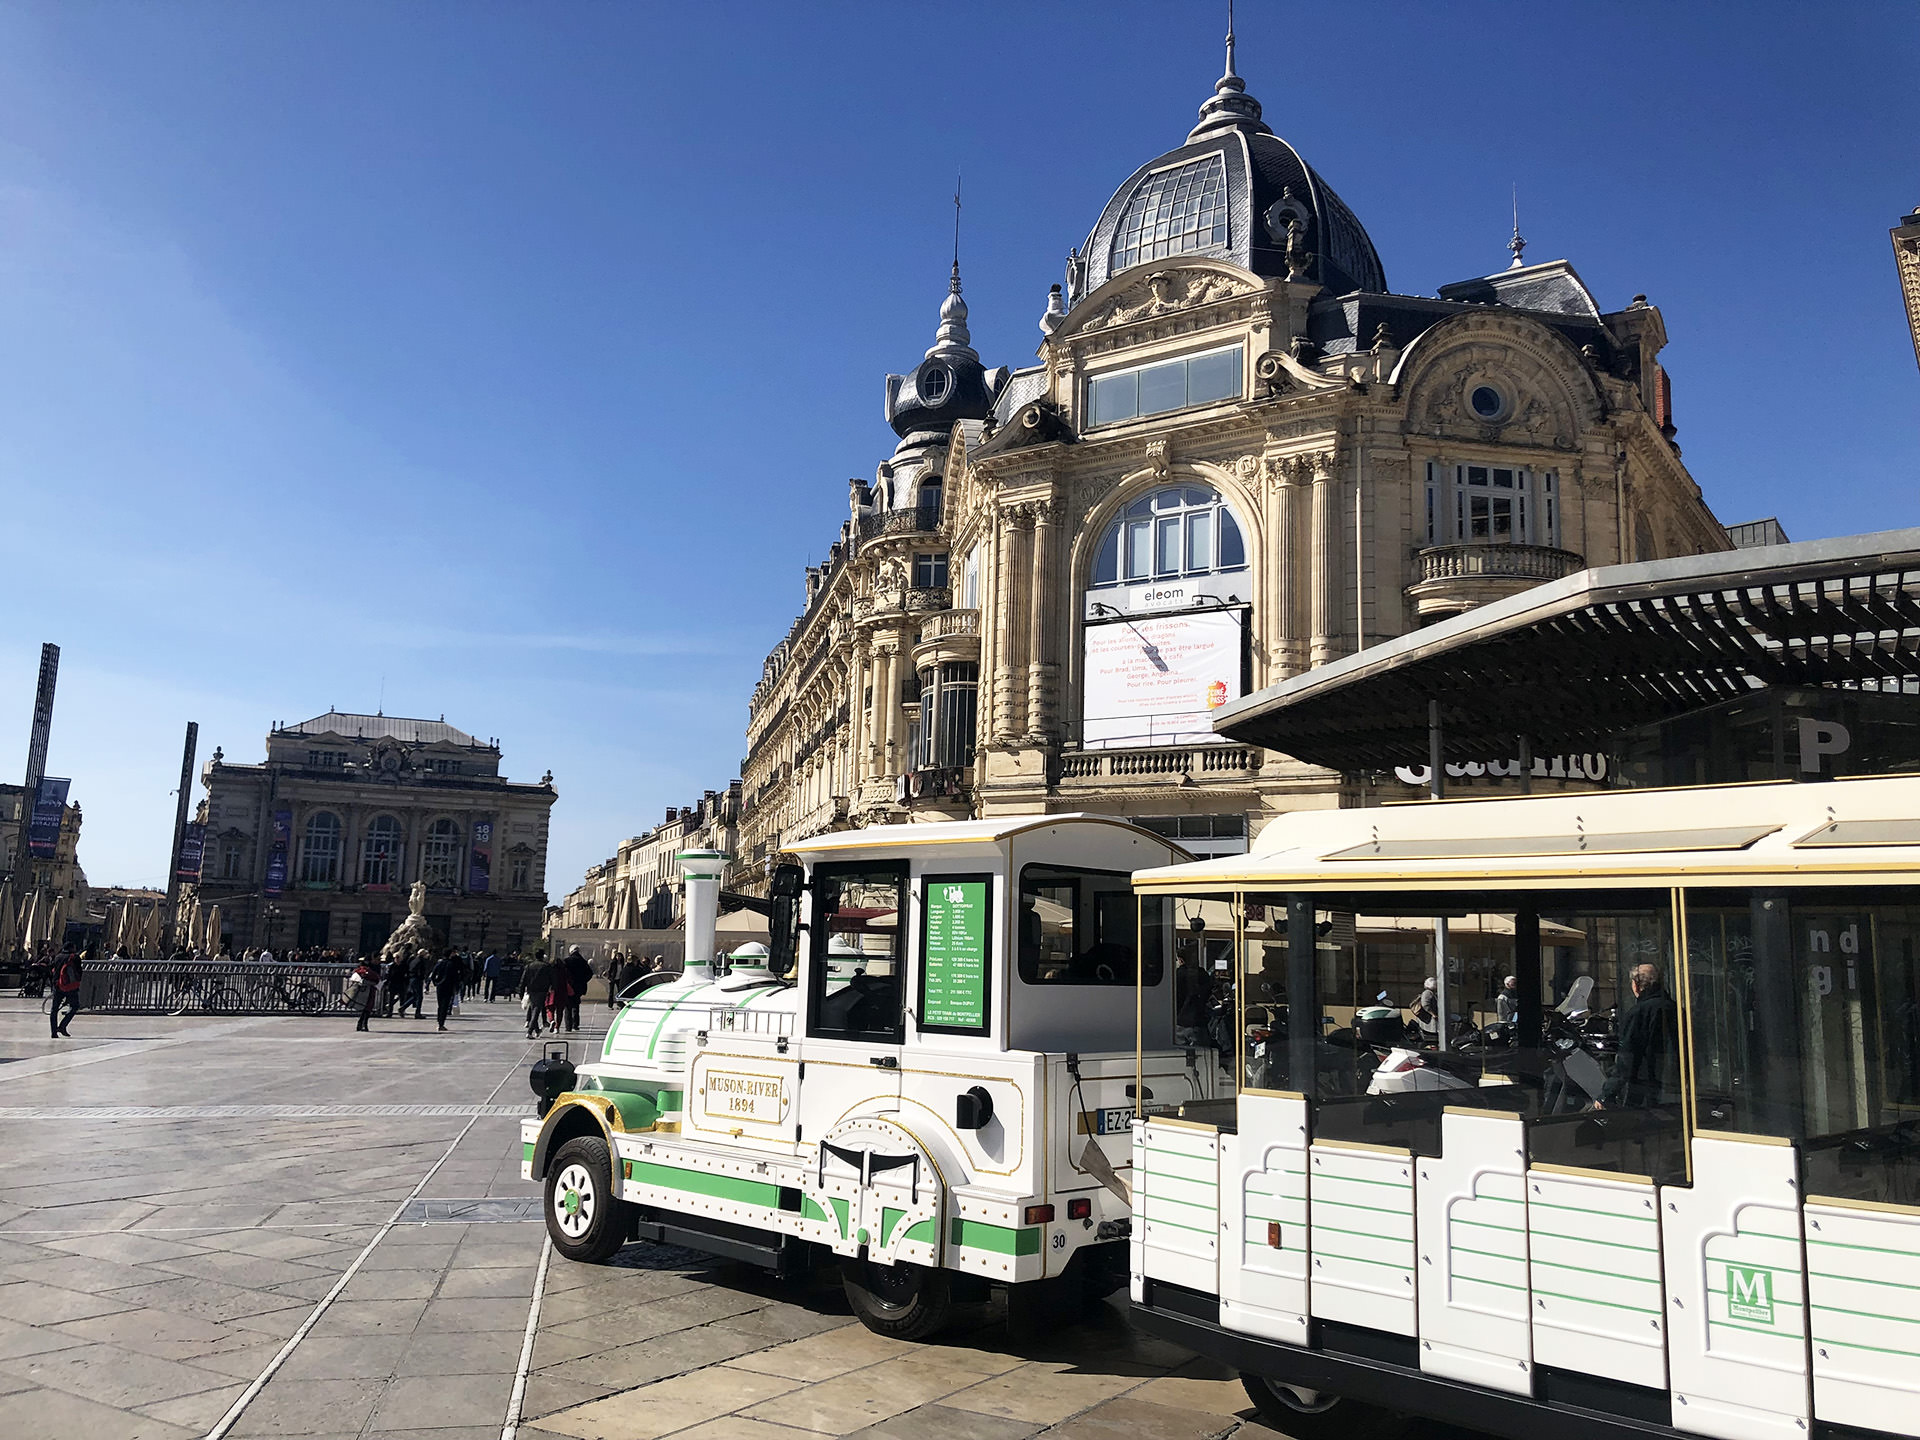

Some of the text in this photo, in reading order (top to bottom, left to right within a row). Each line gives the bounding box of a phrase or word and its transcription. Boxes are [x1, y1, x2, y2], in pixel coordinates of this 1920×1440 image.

[1144, 588, 1184, 601] eleom
[1799, 717, 1850, 773] P
[476, 825, 489, 833] 18
[475, 833, 489, 842] 19
[729, 1097, 754, 1114] 1894
[1052, 1234, 1066, 1249] 30
[1729, 1268, 1770, 1307] M
